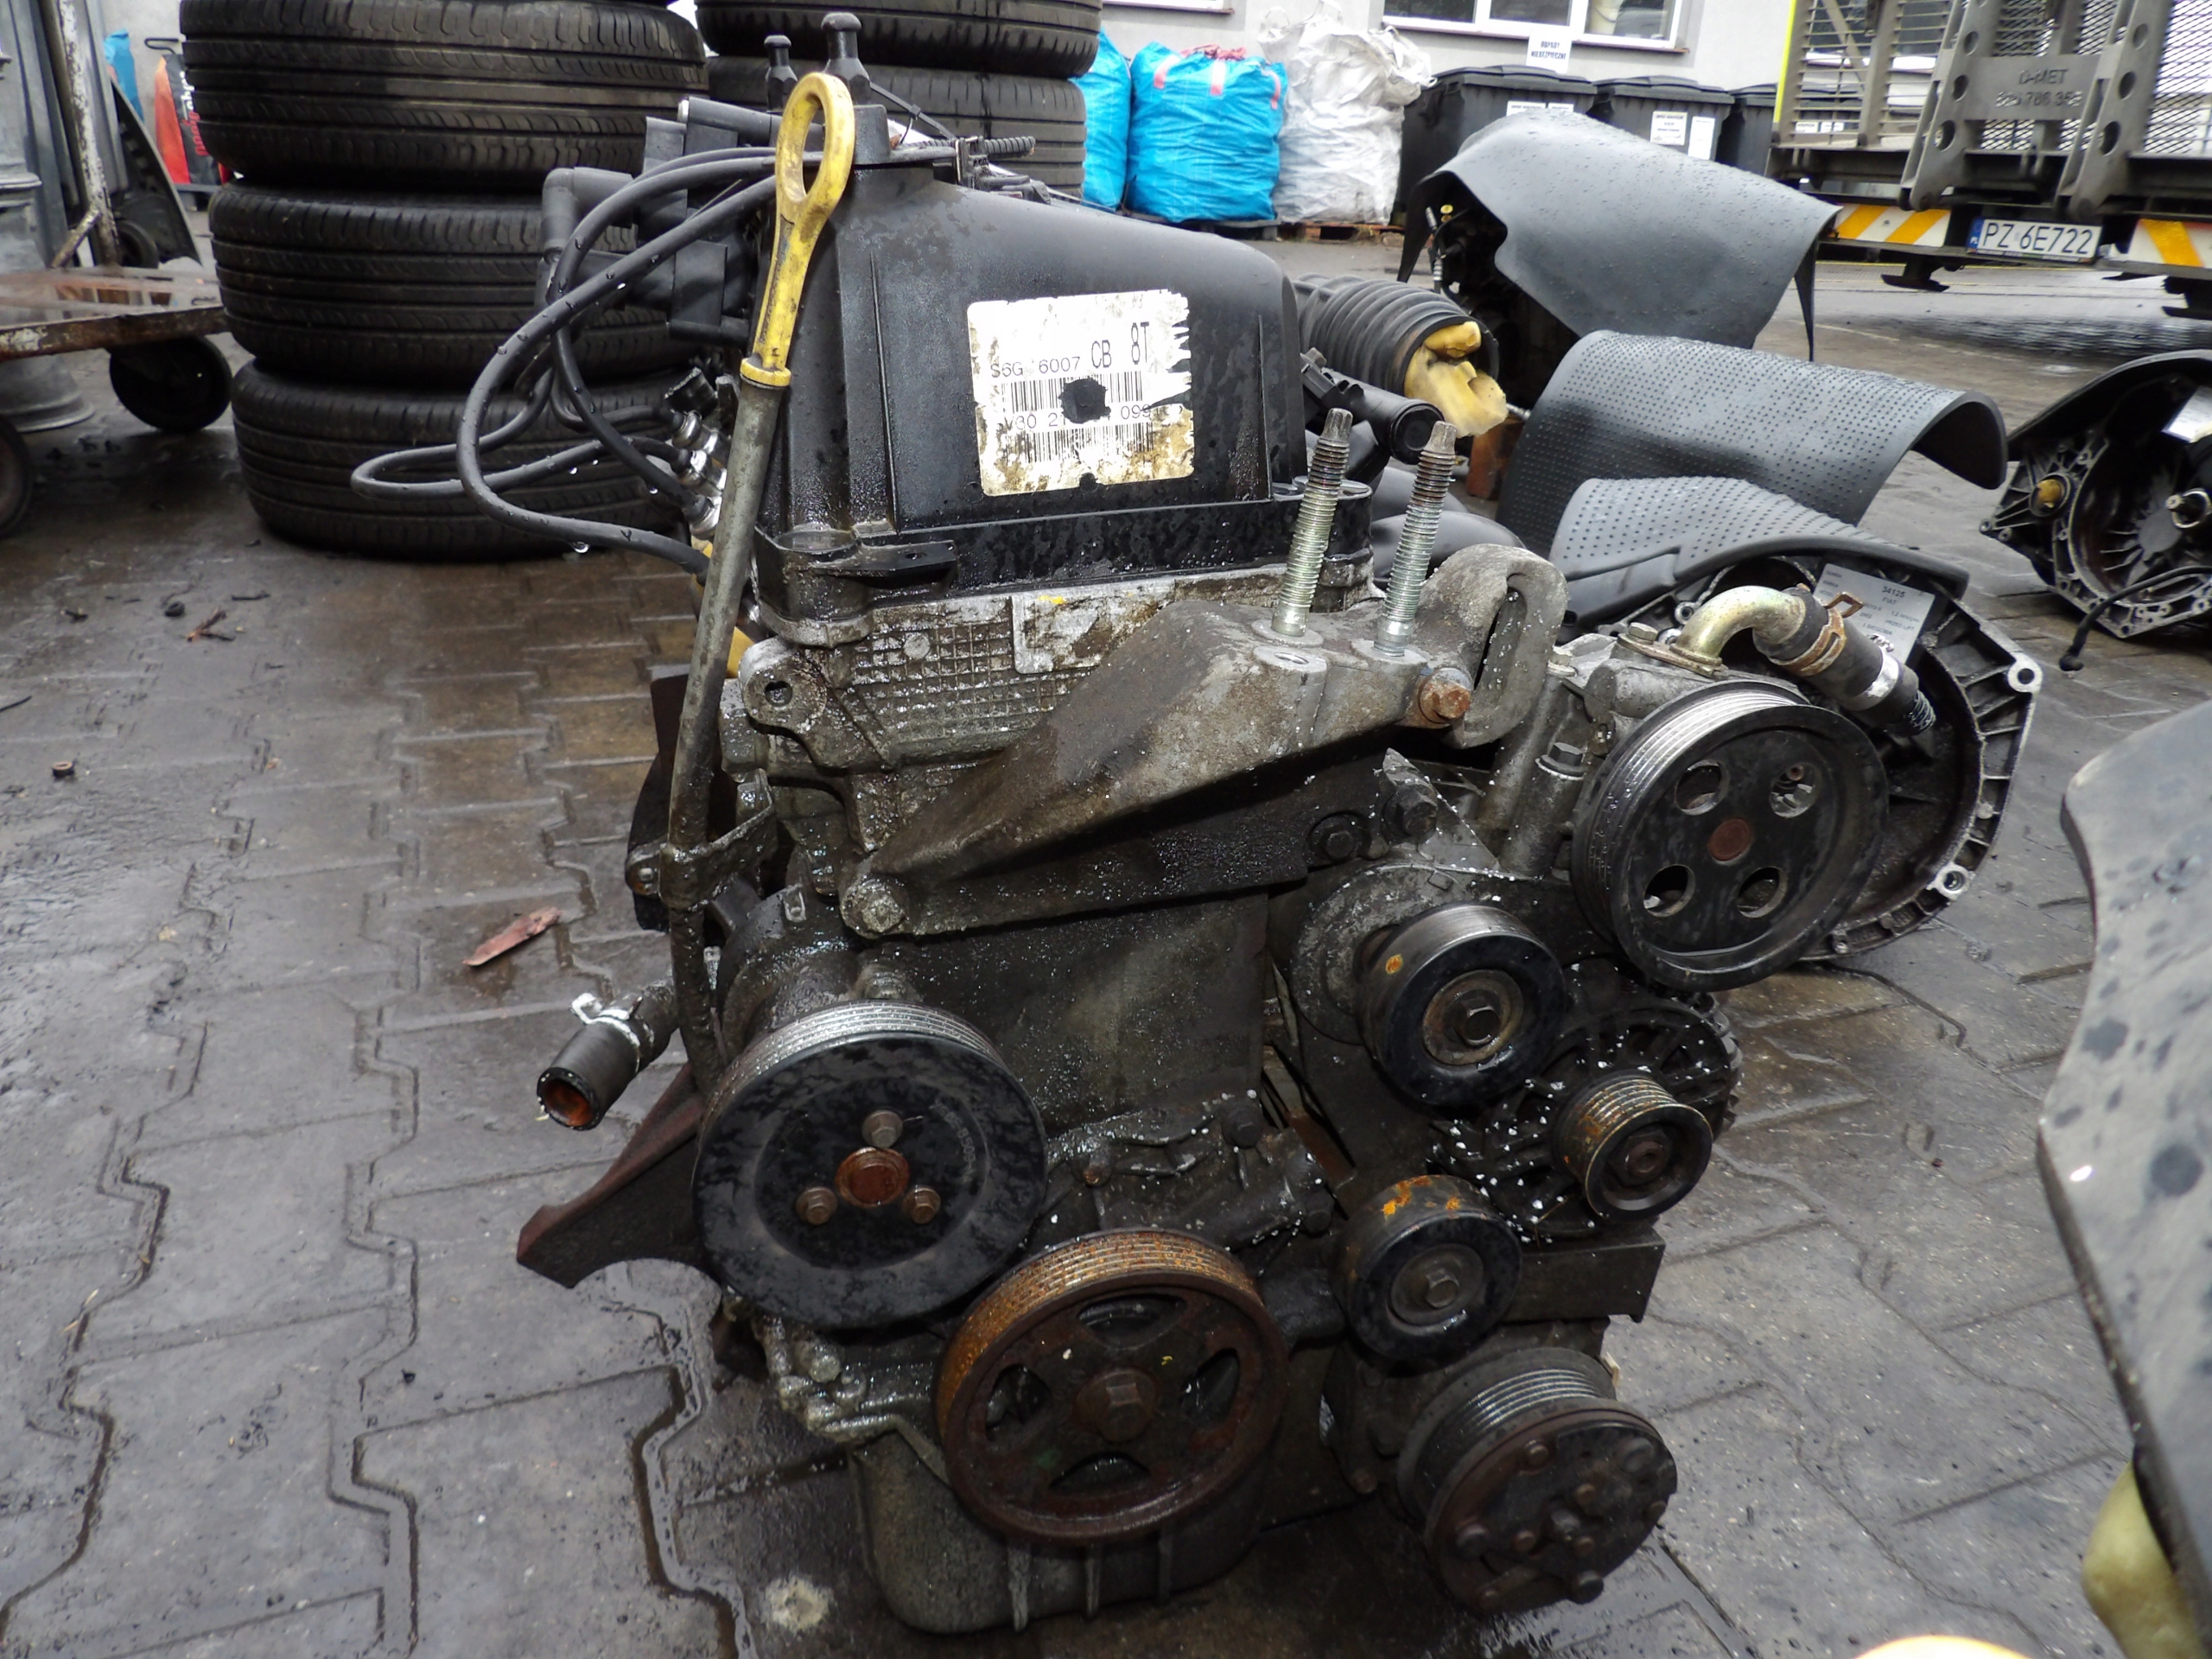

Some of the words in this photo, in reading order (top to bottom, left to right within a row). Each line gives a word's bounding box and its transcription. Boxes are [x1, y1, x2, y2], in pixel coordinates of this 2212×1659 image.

[1982, 222, 2014, 248] PZ
[2019, 225, 2093, 254] 6E722
[1039, 356, 1080, 373] 6007
[1091, 340, 1112, 369] CB
[1131, 321, 1150, 365] 8T
[1882, 586, 1906, 598] 34125
